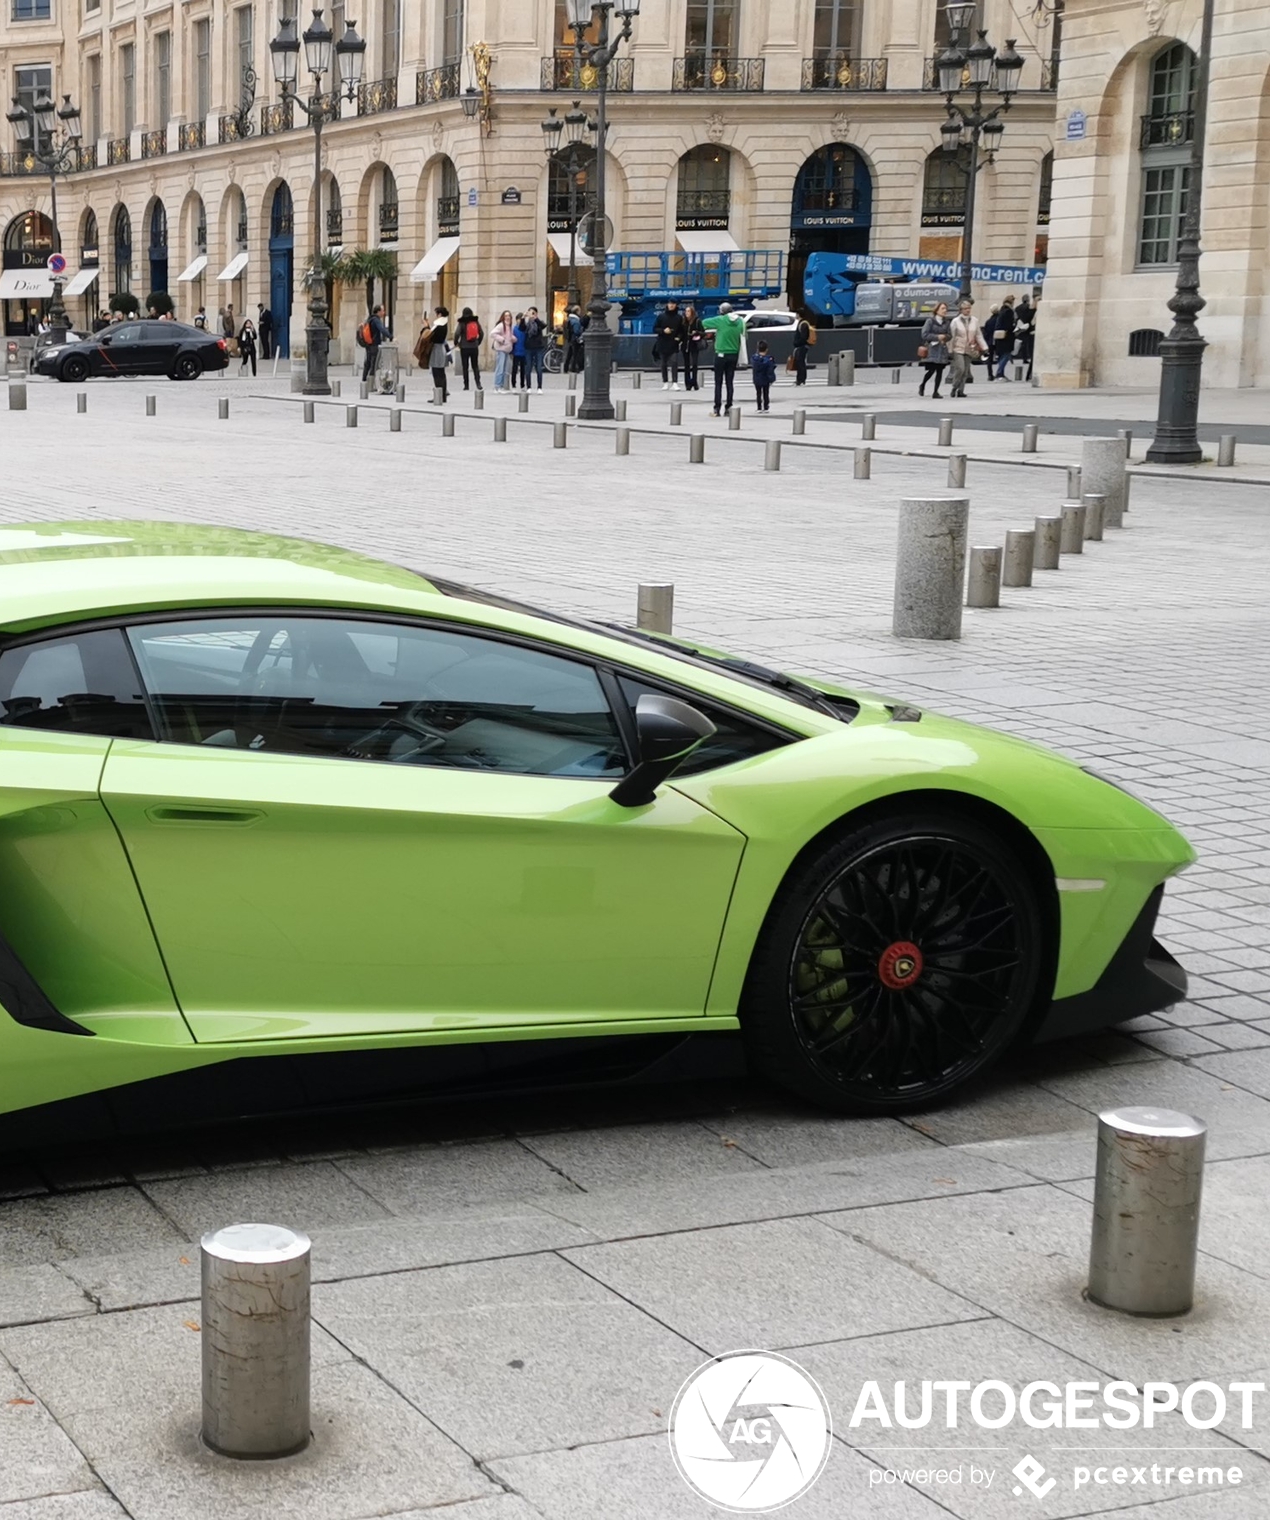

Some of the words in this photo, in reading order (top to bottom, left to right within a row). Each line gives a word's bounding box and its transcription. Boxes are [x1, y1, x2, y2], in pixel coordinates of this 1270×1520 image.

[697, 218, 727, 227] VUITTON
[803, 217, 824, 225] LOUIS
[825, 216, 854, 225] VUITTON
[922, 215, 938, 223] OUIS
[22, 253, 44, 265] Dior
[14, 279, 41, 291] Dior
[903, 287, 952, 298] duma-rent
